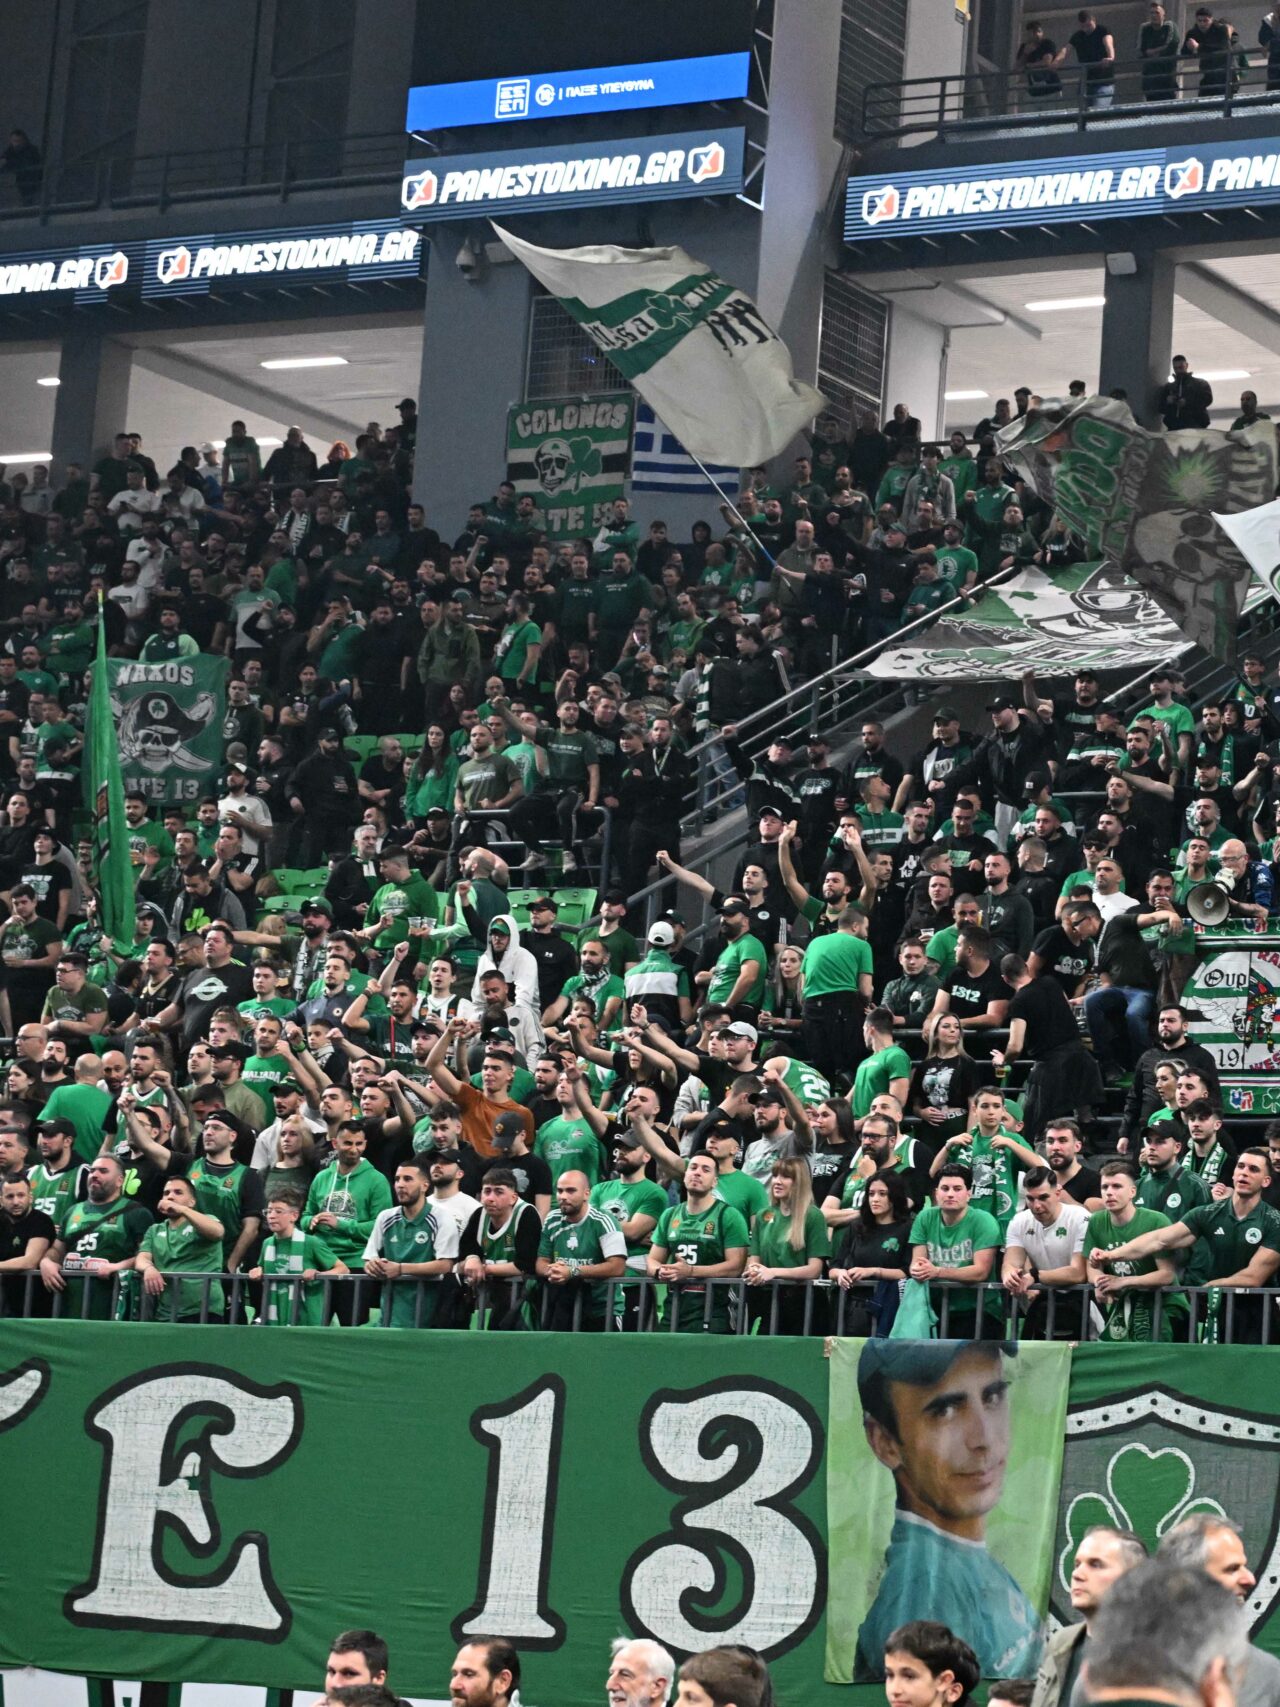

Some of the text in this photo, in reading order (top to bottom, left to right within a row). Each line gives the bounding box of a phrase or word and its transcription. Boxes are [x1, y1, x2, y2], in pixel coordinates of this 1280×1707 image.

[439, 150, 685, 204] PAMESTOIXIMA.GR
[901, 165, 1162, 219] PAMESTOIXIMA.GR
[192, 230, 420, 278] PAMESTOIXIMA.GR
[116, 662, 194, 687] NAXOS
[126, 777, 200, 800] ATE 13
[801, 1074, 831, 1100] 25
[35, 1197, 57, 1216] 25
[76, 1232, 99, 1252] 25
[677, 1244, 699, 1265] 25
[451, 1373, 827, 1663] 13
